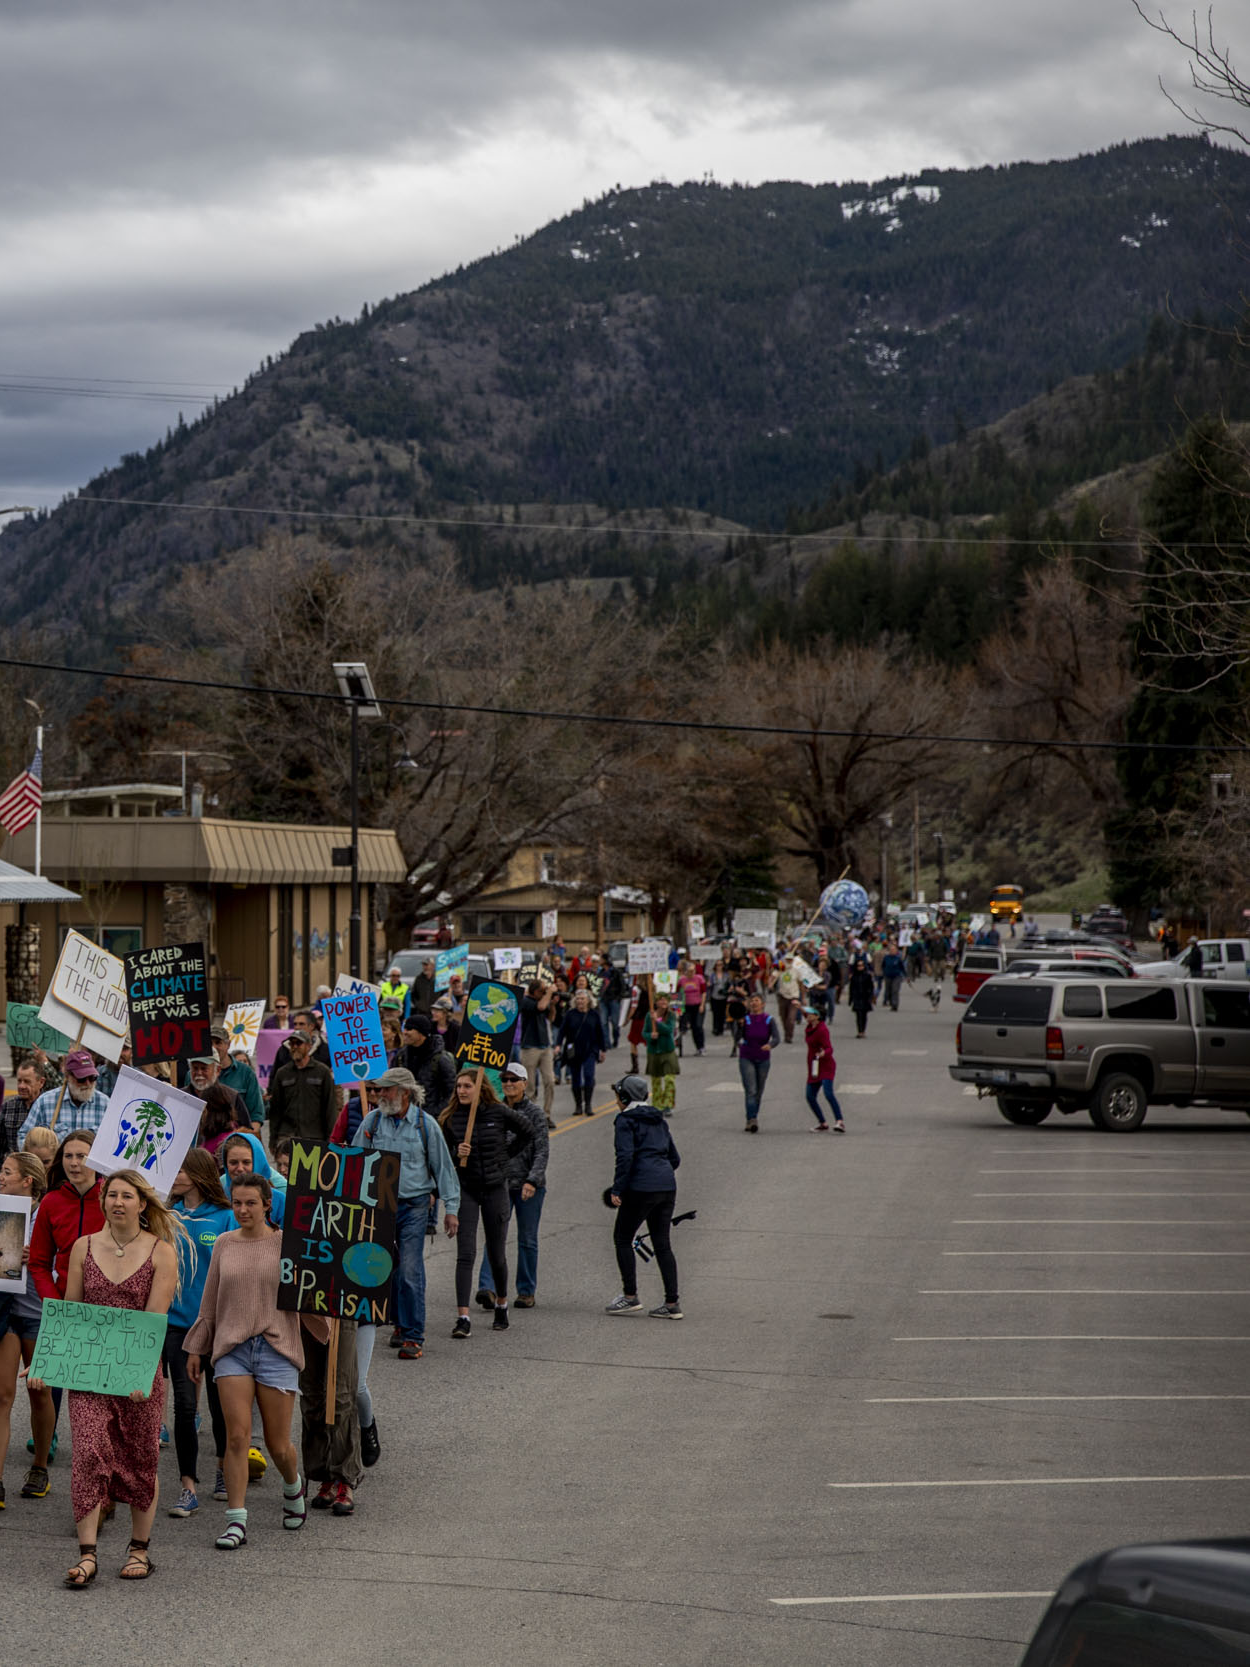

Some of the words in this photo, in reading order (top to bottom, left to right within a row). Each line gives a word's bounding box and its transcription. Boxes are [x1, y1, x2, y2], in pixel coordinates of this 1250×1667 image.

[74, 938, 110, 980] THIS
[128, 956, 138, 969] I
[139, 947, 183, 965] CARED
[134, 962, 175, 980] ABOUT
[178, 959, 204, 972] THE
[65, 964, 95, 1002] THE
[130, 974, 206, 998] CLIMATE
[132, 994, 186, 1013] BEFORE
[144, 1010, 158, 1021] IT
[164, 1003, 200, 1018] WAS
[229, 1001, 262, 1011] CLIMATE
[324, 995, 375, 1021] POWER
[337, 1028, 372, 1045] THE
[341, 1016, 364, 1032] TO
[135, 1020, 209, 1058] HOT
[472, 1032, 492, 1048] #
[333, 1044, 382, 1068] PEOPLE
[288, 1139, 401, 1213] MOTHER
[291, 1196, 377, 1243] EARTH
[301, 1237, 334, 1263] IS
[46, 1301, 93, 1322] SHEAD
[96, 1308, 135, 1330] SOME
[42, 1318, 82, 1340] LOVE
[87, 1326, 111, 1345] ON
[118, 1329, 157, 1350] THIS
[37, 1336, 141, 1366] BEAUTIFUL
